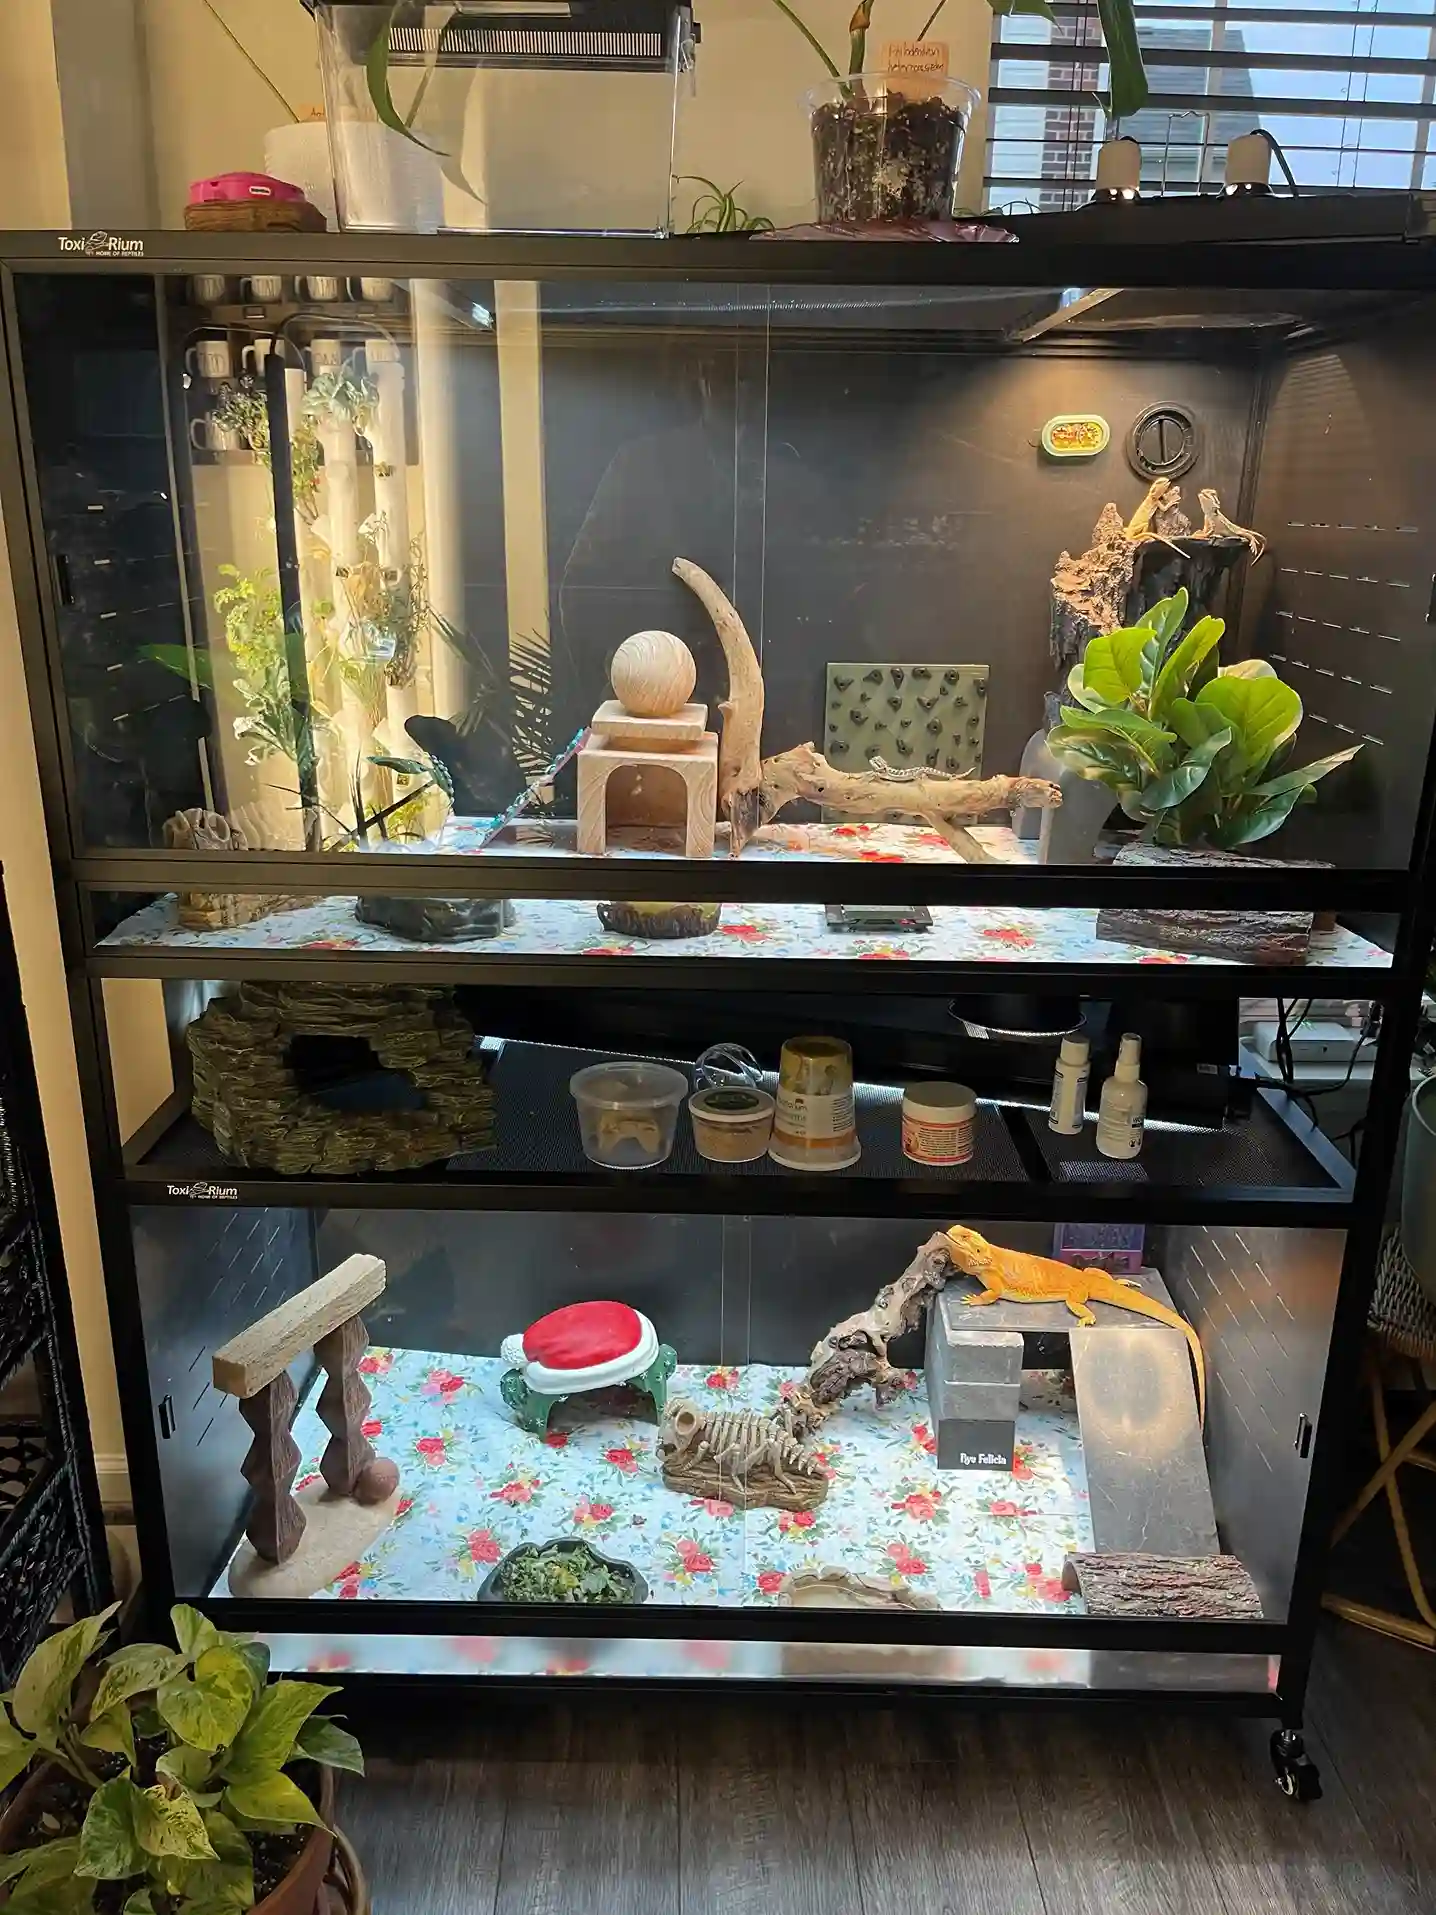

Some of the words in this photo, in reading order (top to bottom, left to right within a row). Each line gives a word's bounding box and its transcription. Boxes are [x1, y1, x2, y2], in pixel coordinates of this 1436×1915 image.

[57, 236, 85, 251] Toxi
[108, 237, 144, 251] Rium
[166, 1185, 189, 1195] Toxi
[208, 1185, 238, 1196] Rium
